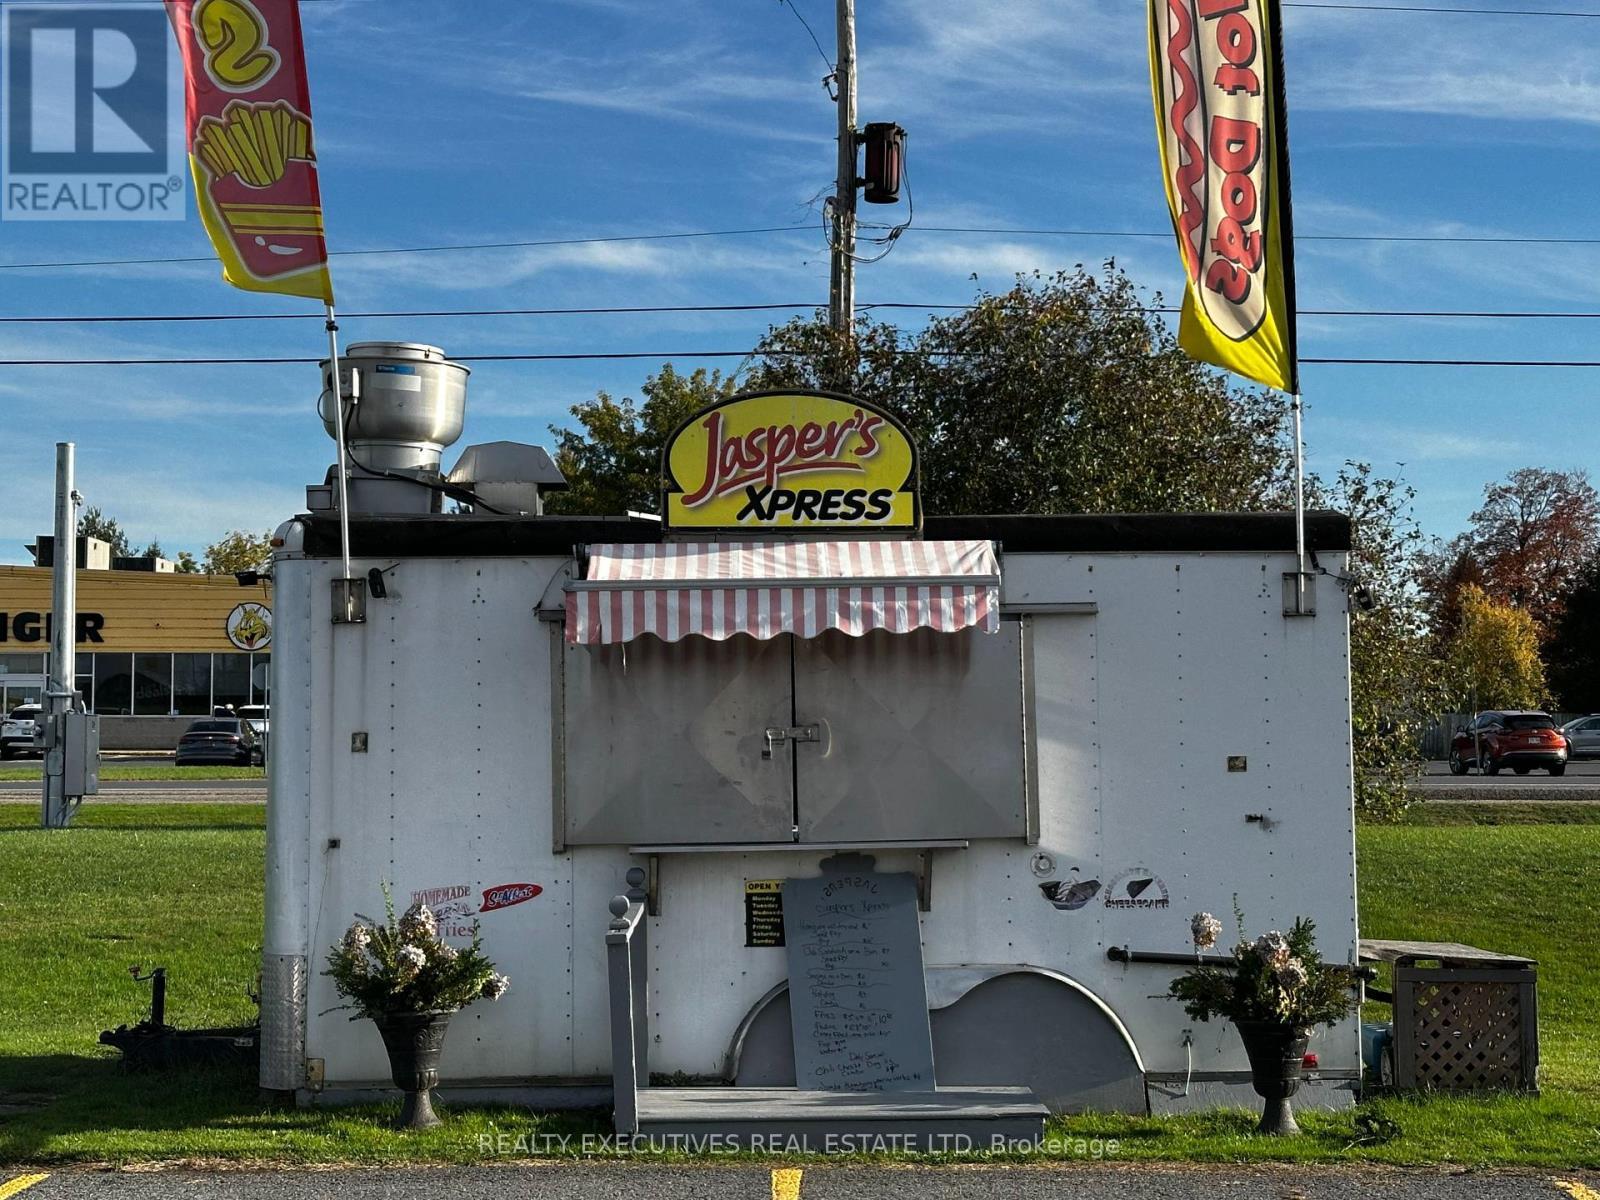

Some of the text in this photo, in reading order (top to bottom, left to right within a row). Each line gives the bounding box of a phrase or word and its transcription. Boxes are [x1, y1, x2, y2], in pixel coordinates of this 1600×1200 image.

[681, 408, 887, 508] Jasper's
[735, 484, 896, 522] XPRESS
[410, 885, 471, 906] HOMEMADE
[748, 882, 771, 891] OPEN
